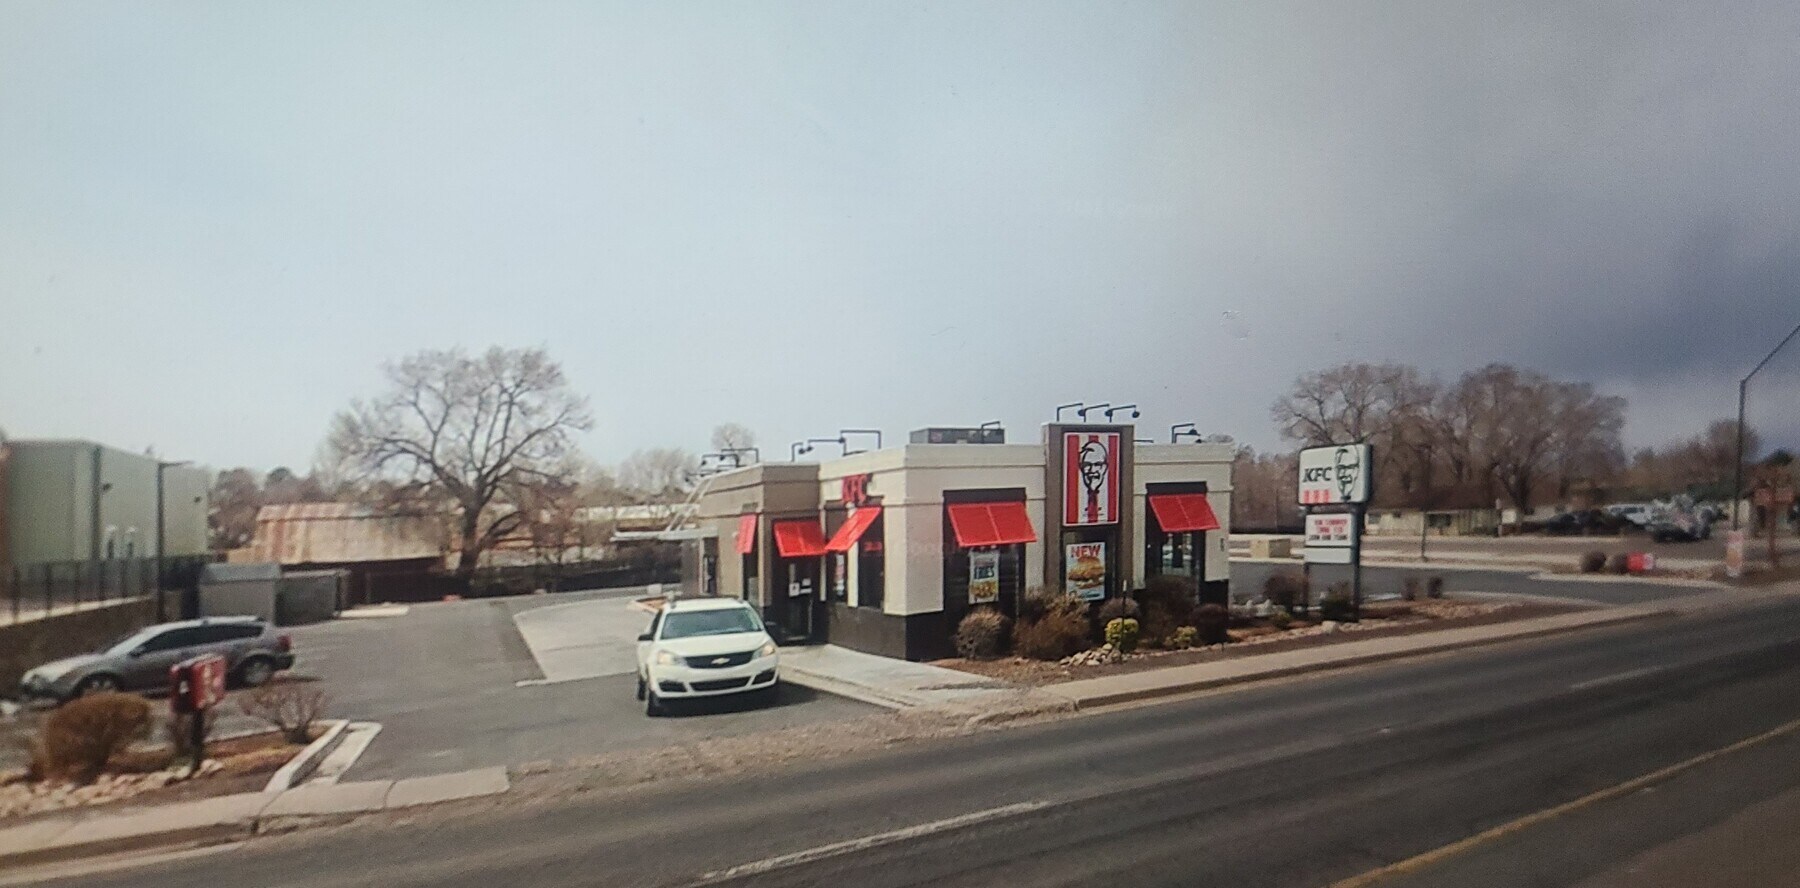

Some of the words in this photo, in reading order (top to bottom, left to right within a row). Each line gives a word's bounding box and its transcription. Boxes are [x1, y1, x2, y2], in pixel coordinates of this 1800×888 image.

[1303, 467, 1333, 483] KFC
[842, 474, 868, 503] KFC
[1071, 545, 1101, 558] NEW
